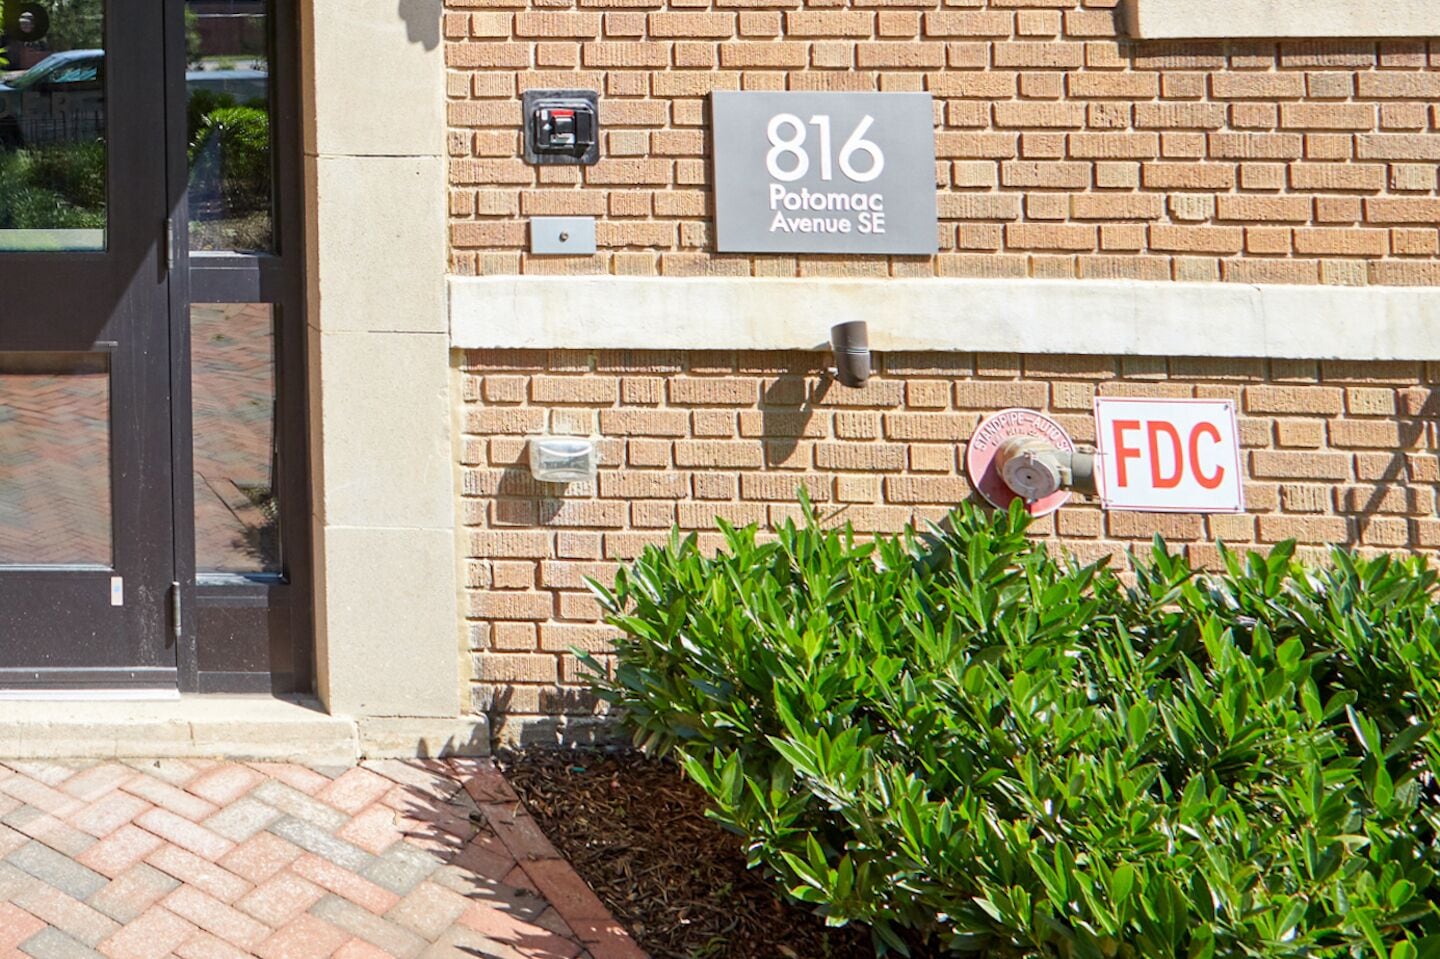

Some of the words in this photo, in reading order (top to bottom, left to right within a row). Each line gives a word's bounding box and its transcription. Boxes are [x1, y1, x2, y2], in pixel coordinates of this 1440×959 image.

[765, 112, 885, 183] 816
[769, 183, 884, 212] Potomac
[769, 211, 852, 234] Avenue
[857, 212, 885, 234] SE
[1112, 419, 1225, 490] FDC
